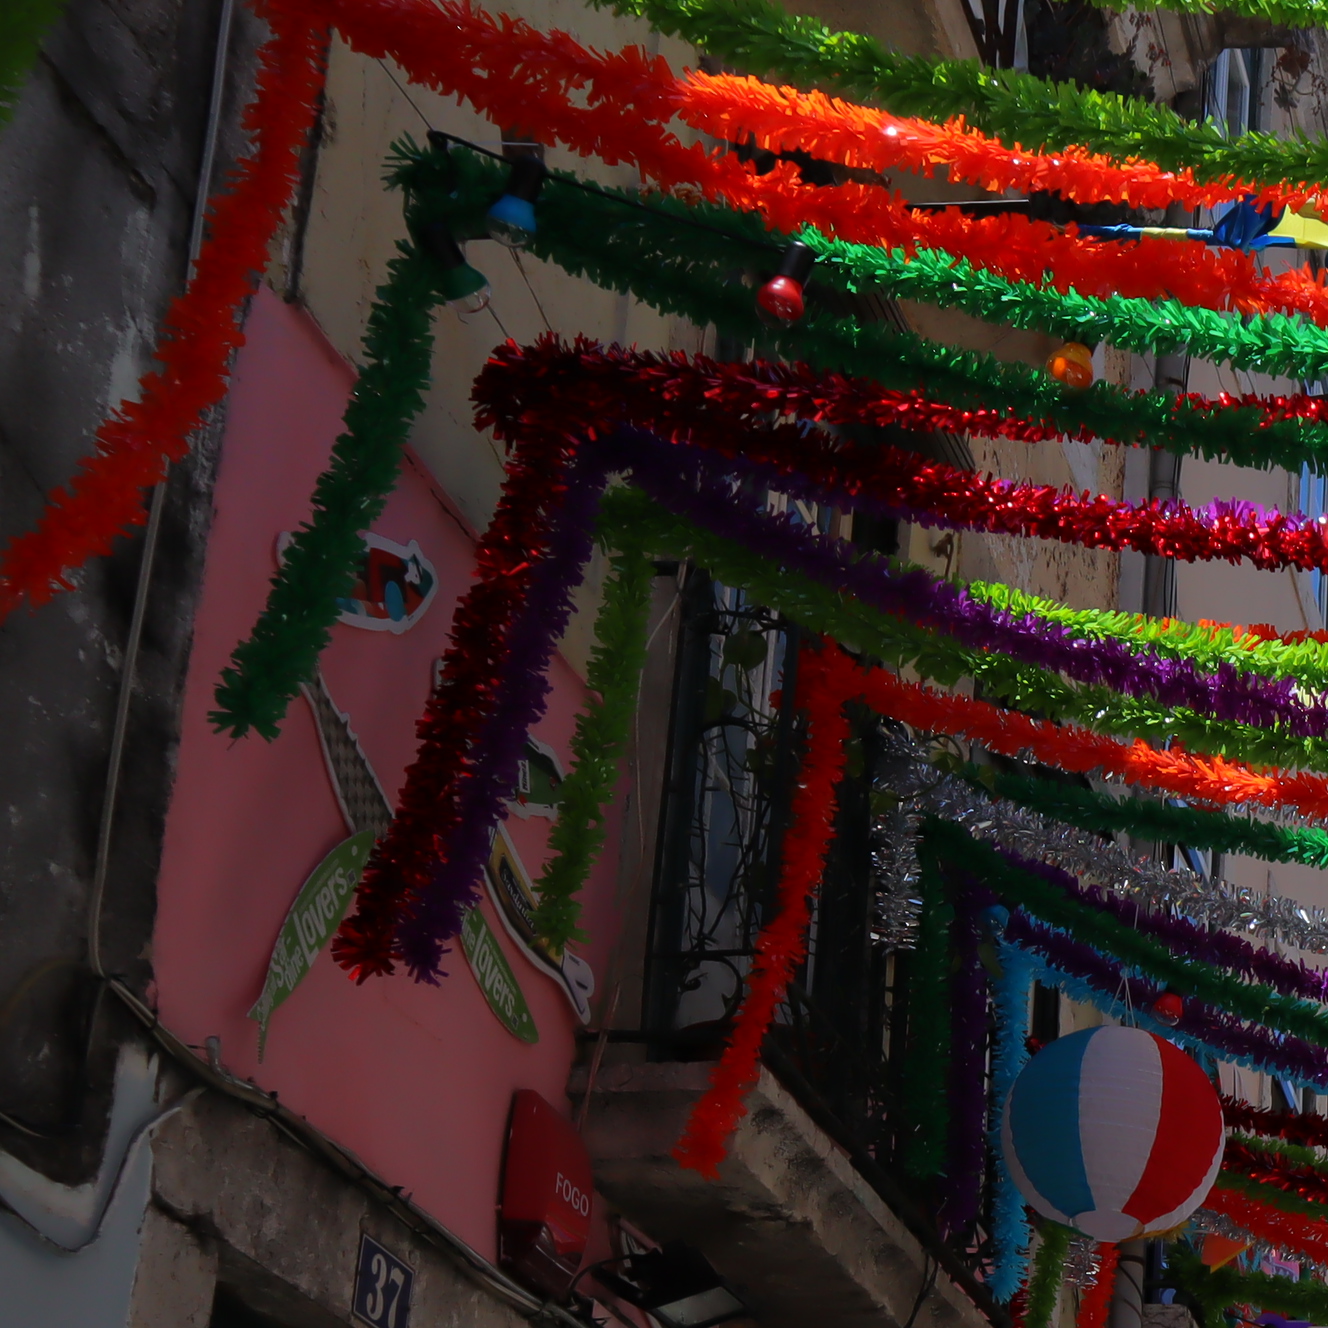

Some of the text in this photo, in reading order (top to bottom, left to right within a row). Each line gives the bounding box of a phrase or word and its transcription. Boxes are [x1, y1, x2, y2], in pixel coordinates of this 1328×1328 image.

[293, 867, 348, 968] Lovers
[471, 923, 516, 1021] Lovers
[555, 1172, 589, 1217] FOGO
